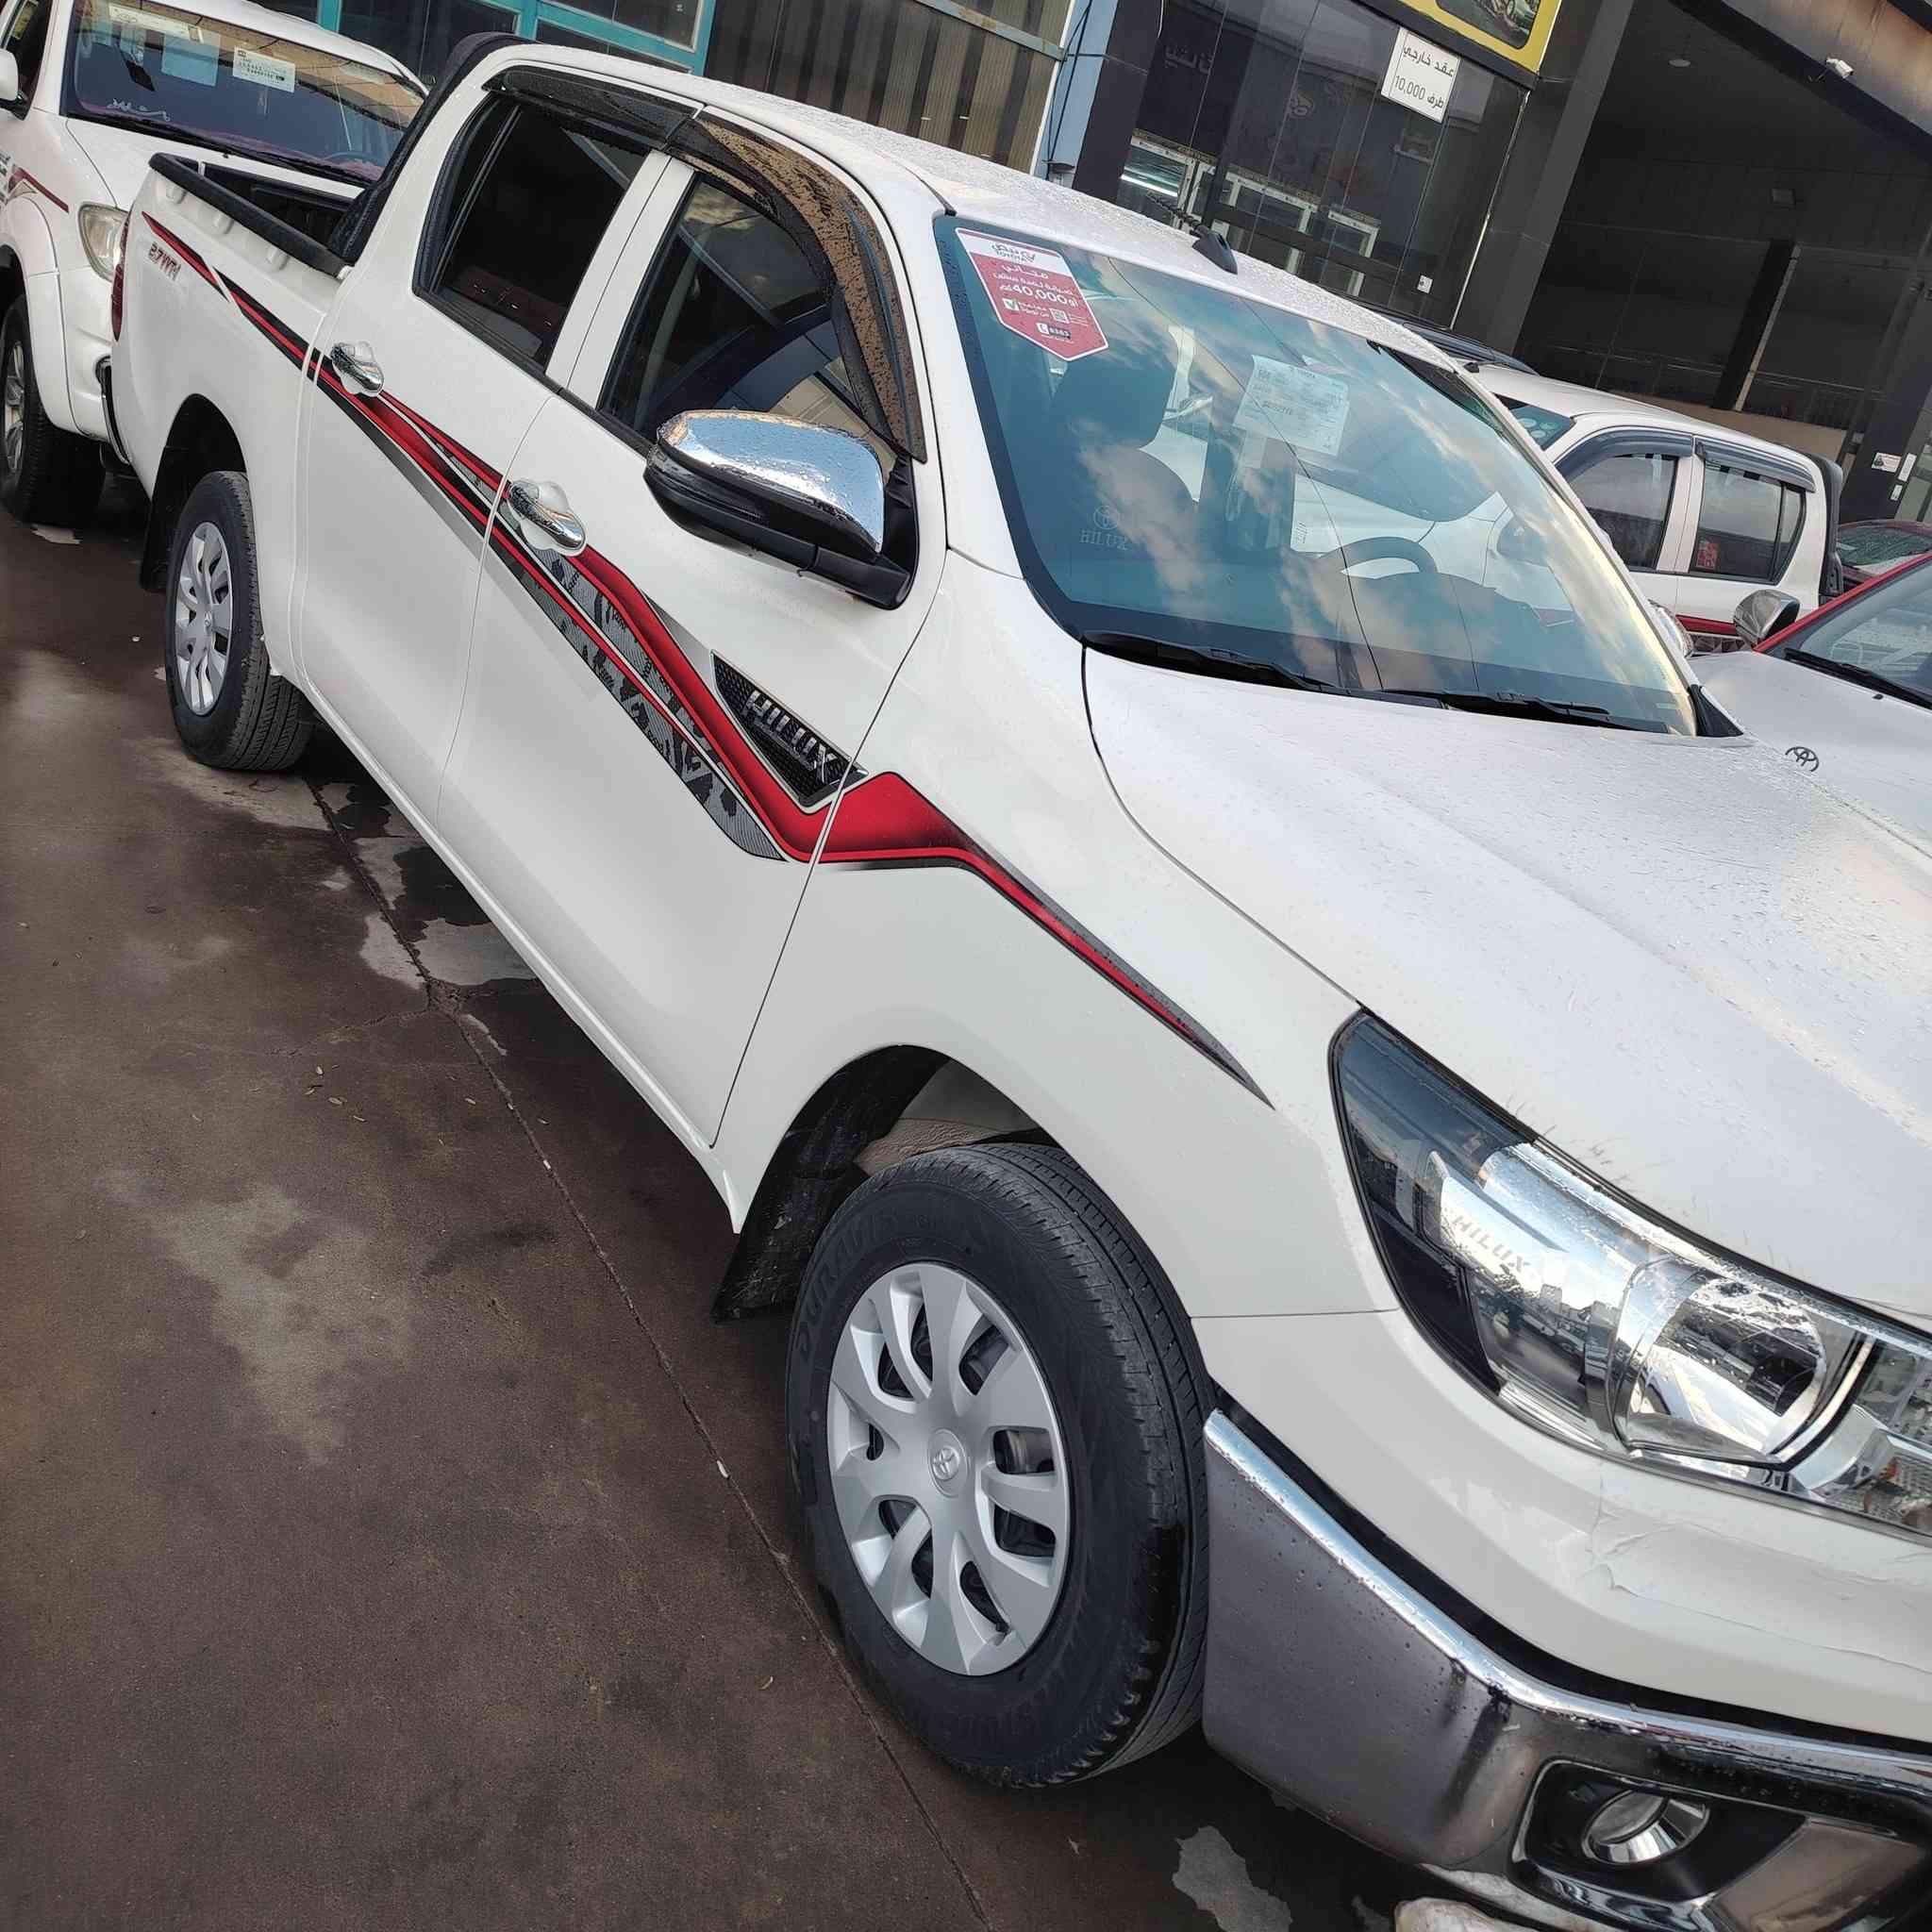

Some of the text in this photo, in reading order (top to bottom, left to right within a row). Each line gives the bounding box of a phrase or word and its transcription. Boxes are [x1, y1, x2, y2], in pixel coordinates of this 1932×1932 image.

[1403, 46, 1455, 77] عقد خارجي
[1395, 75, 1426, 101] 10,000
[739, 690, 838, 785] HILUX
[1452, 1215, 1531, 1273] HILUX
